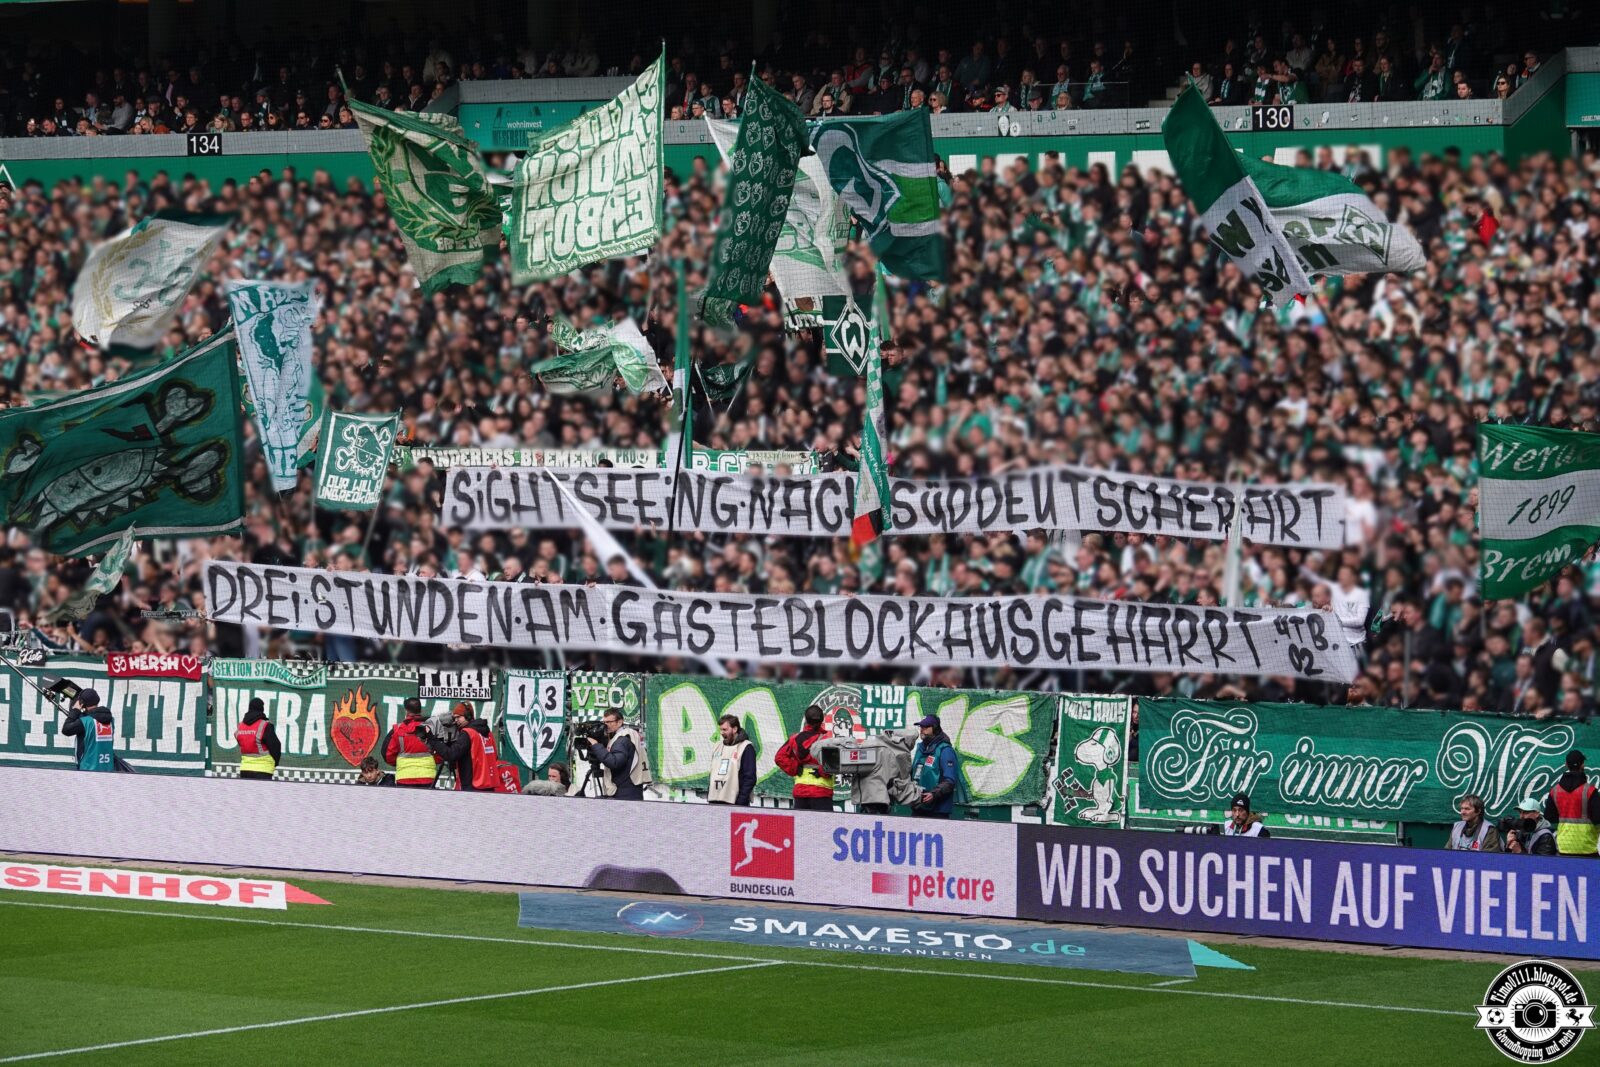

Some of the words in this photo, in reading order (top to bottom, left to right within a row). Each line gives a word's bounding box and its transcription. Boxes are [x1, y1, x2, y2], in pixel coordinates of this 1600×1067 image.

[506, 120, 542, 129] wohninvest
[1255, 107, 1291, 129] 130
[190, 135, 219, 154] 134
[1244, 488, 1335, 542] ART
[1507, 485, 1576, 525] 1899
[310, 575, 512, 643] STUNDEN
[520, 587, 596, 645] AM
[612, 590, 937, 660] GÄSTEBLOCK
[943, 598, 1262, 669] AUSGEHARRT
[129, 655, 180, 671] HERSH
[215, 662, 252, 677] SEKTION
[1288, 643, 1324, 676] 02
[421, 686, 491, 698] UNVERGESSEN
[98, 753, 110, 764] 25
[1147, 708, 1273, 802] Für
[1279, 737, 1429, 809] immer
[714, 780, 727, 791] TV
[832, 820, 944, 868] saturn
[4, 866, 273, 904] SENHOF
[730, 883, 795, 897] BUNDESLIGA
[908, 871, 995, 907] petcare
[1037, 842, 1122, 911] WIR
[1139, 848, 1312, 924] SUCHEN
[1330, 861, 1417, 931] AUF
[1432, 867, 1588, 943] VIELEN
[902, 948, 992, 961] ANLEGEN
